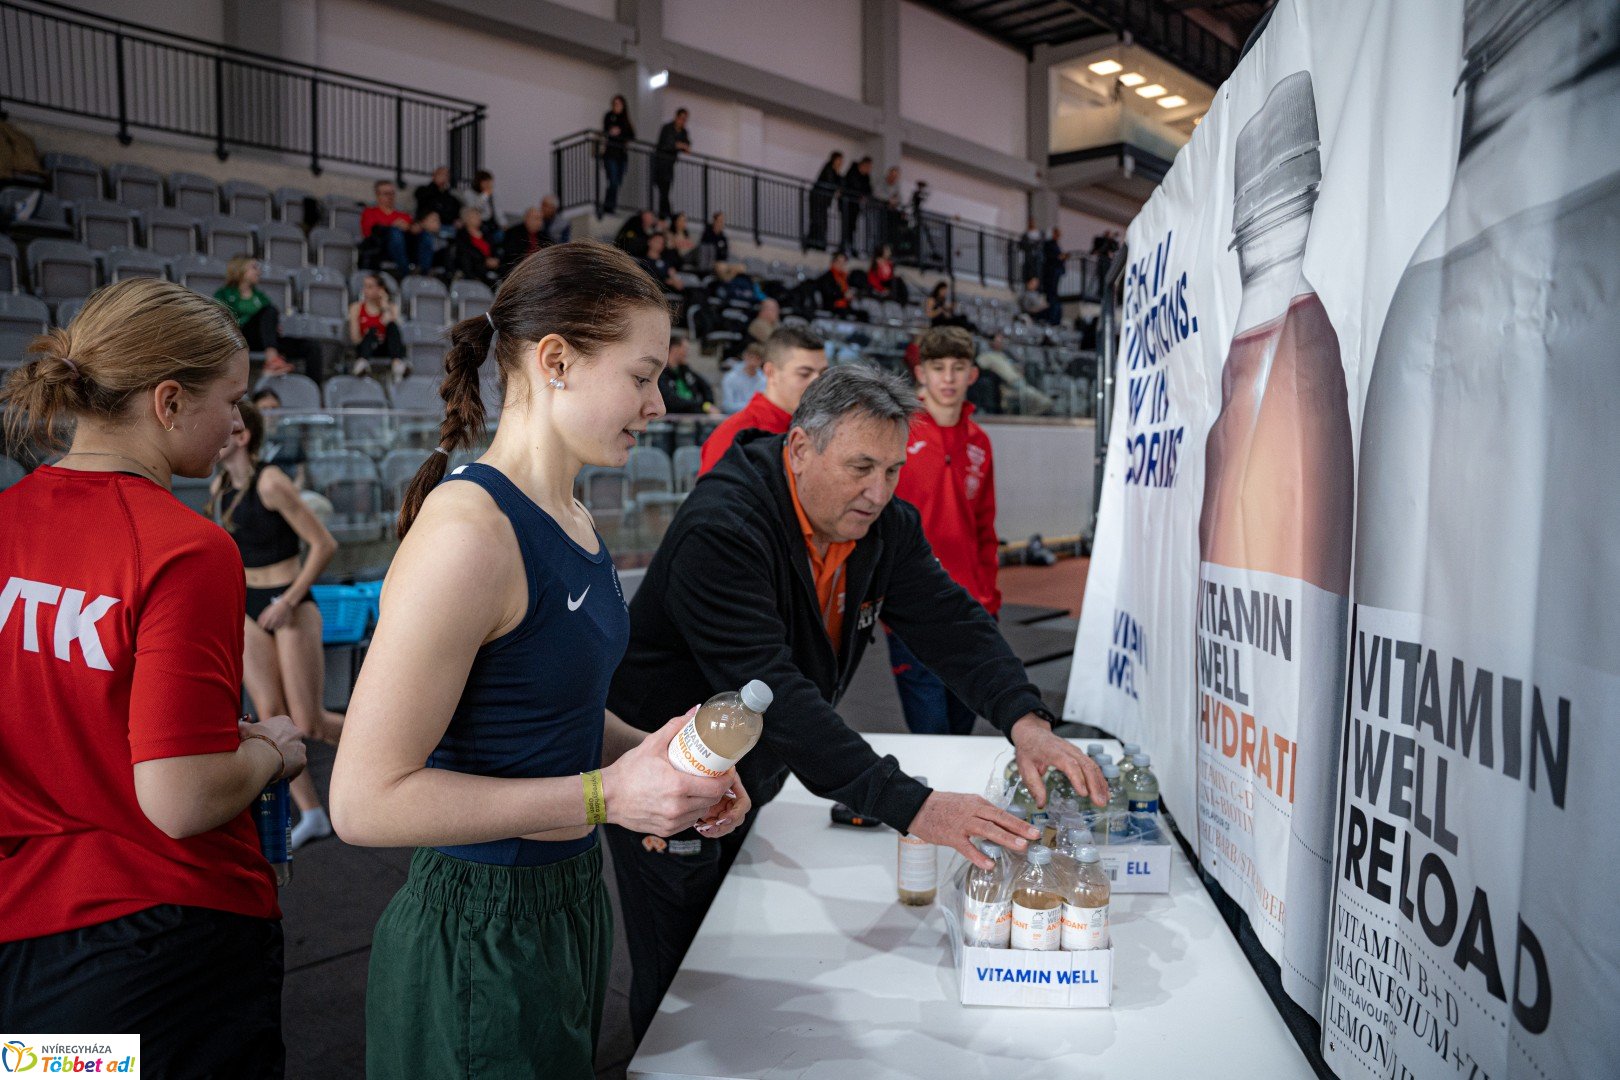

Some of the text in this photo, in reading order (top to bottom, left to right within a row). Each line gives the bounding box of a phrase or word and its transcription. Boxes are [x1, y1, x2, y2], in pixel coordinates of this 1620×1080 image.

[1359, 630, 1571, 811] VITAMIN
[1354, 717, 1459, 857] WELL
[1127, 861, 1151, 875] ELL
[1344, 803, 1553, 1035] RELOAD
[976, 967, 1099, 984] VITAMIN WELL
[1337, 903, 1459, 1028] VITAMIN B+D
[1348, 987, 1390, 1027] FLAVOUR
